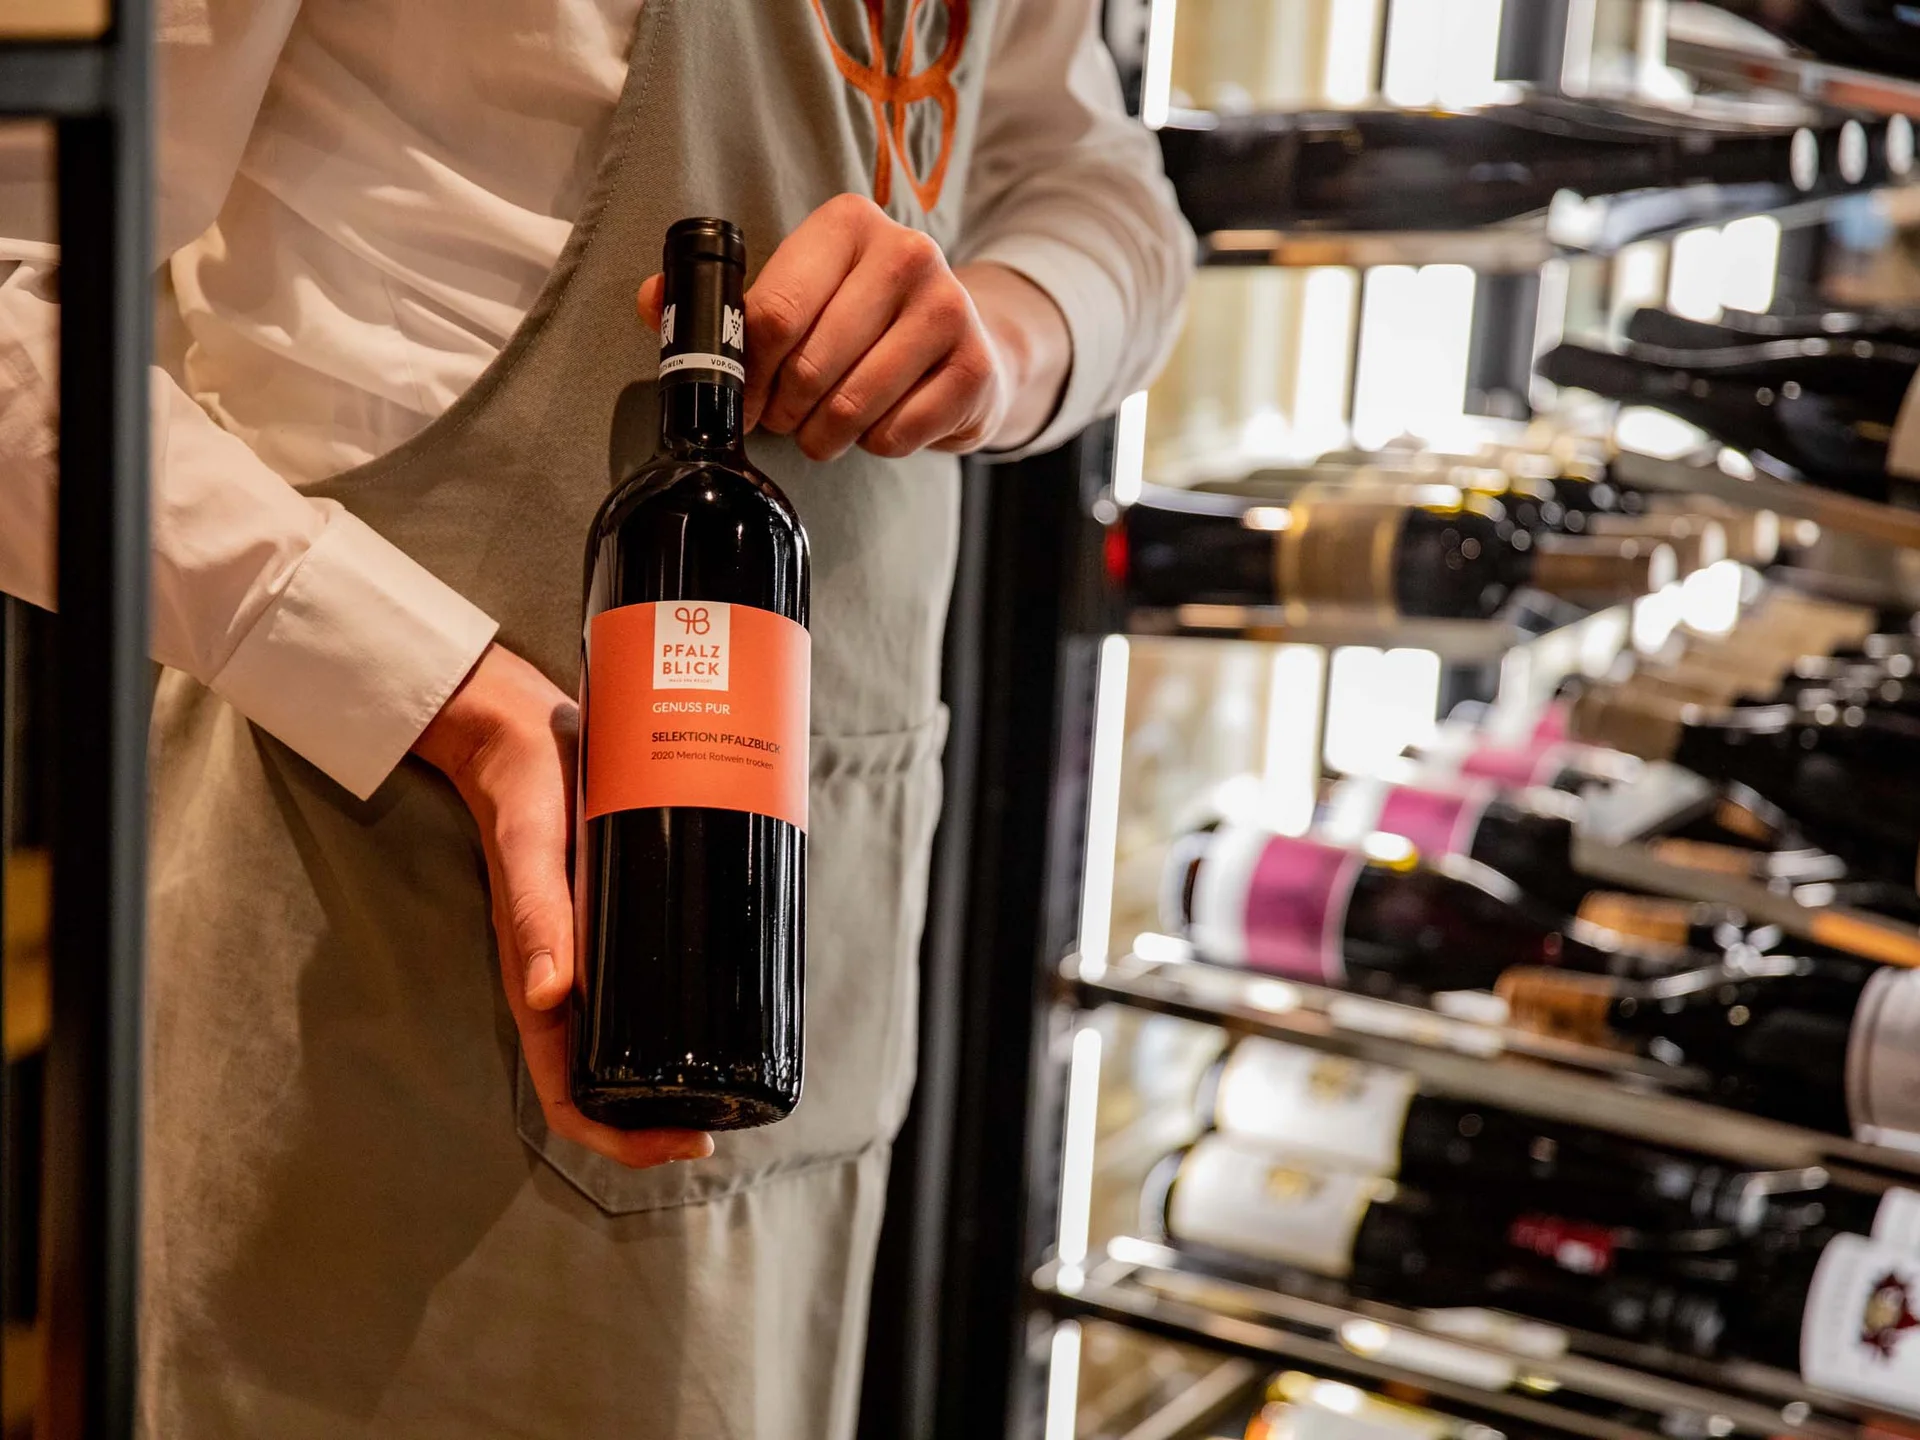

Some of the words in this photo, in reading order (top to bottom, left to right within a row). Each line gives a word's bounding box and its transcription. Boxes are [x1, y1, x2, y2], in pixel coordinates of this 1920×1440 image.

[663, 644, 720, 658] PFALZ
[662, 661, 719, 675] BLICK
[652, 702, 702, 713] GENUSS
[705, 702, 731, 715] PUR
[651, 731, 718, 743] SELEKTION
[720, 733, 781, 754] PFALZBLICK
[651, 750, 675, 760] 2020
[676, 751, 707, 760] Merlot
[709, 752, 744, 764] Rotwein
[745, 756, 774, 770] trocken
